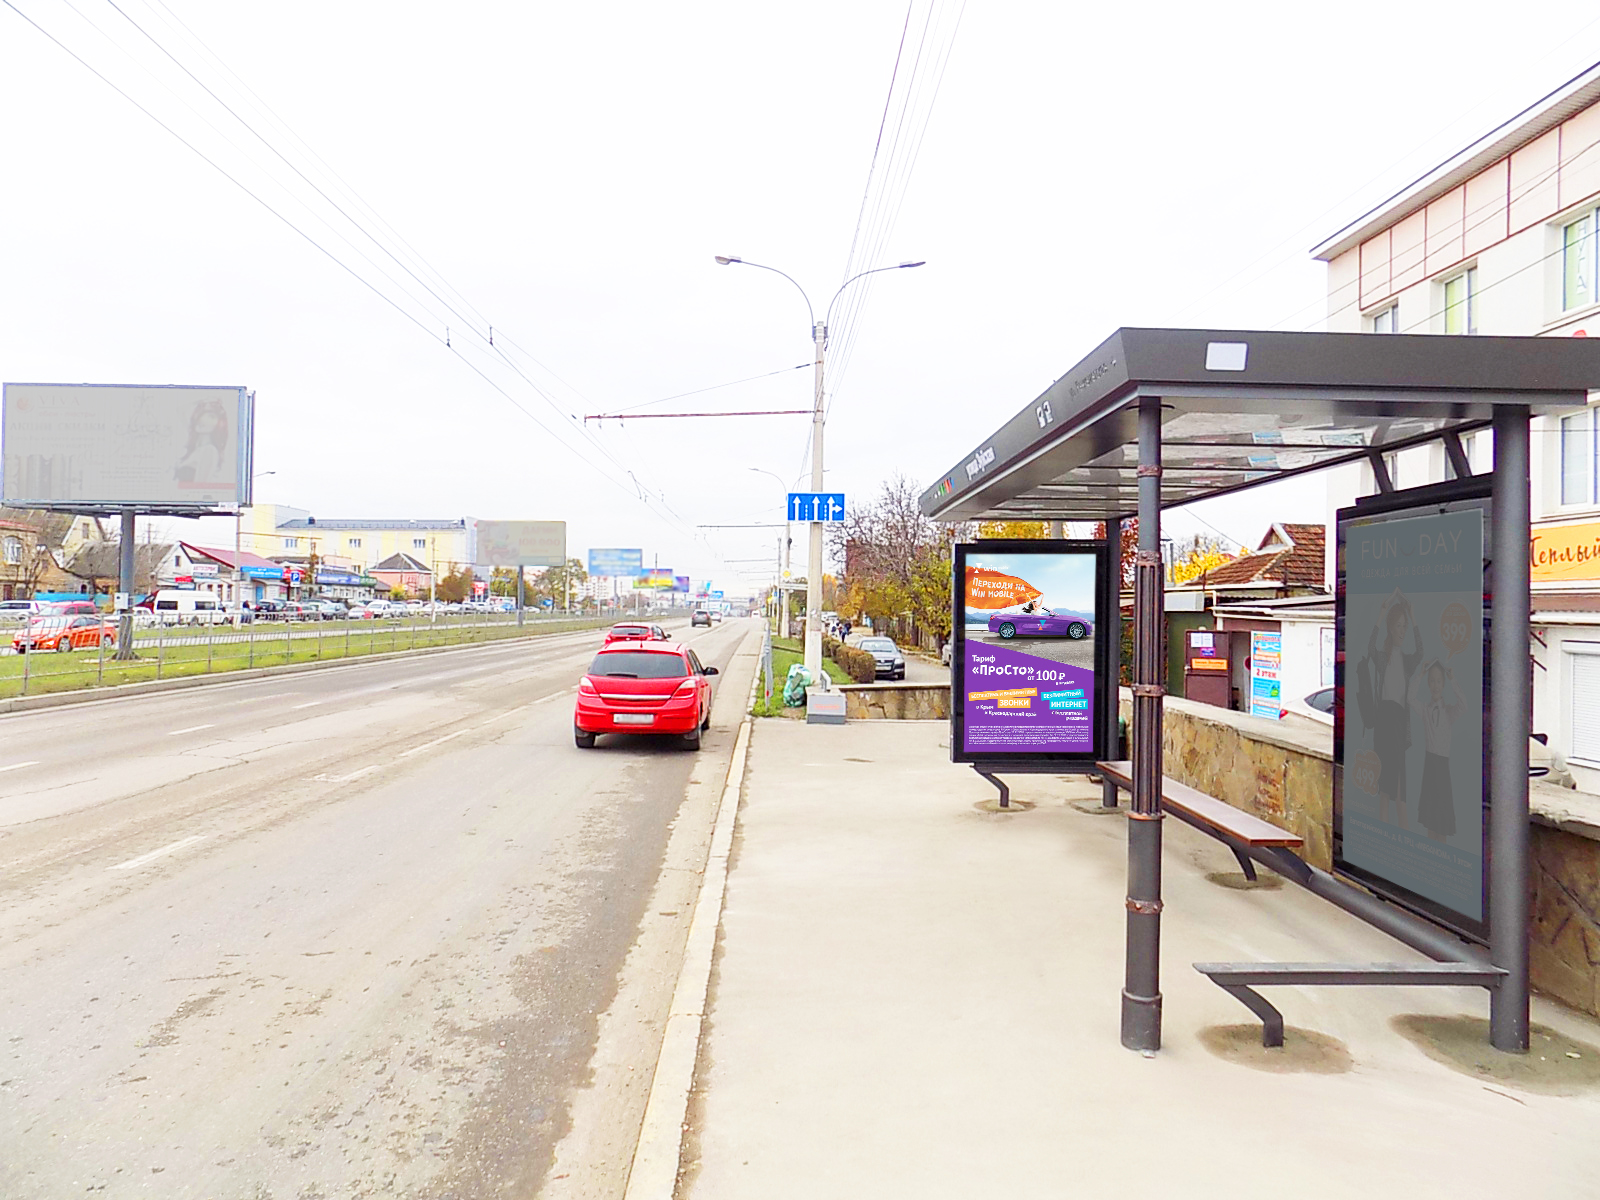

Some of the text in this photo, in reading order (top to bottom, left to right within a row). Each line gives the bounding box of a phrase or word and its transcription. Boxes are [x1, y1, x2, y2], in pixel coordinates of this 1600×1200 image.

[39, 395, 80, 406] VIVA
[1361, 529, 1462, 560] FUN DAY
[983, 564, 998, 572] win
[1361, 563, 1462, 578] ОДЕЖДА ДЛЯ ВСЕЙ СЕМЬИ
[1015, 584, 1026, 592] НА
[972, 655, 996, 663] Тариф
[1036, 670, 1057, 681] 100
